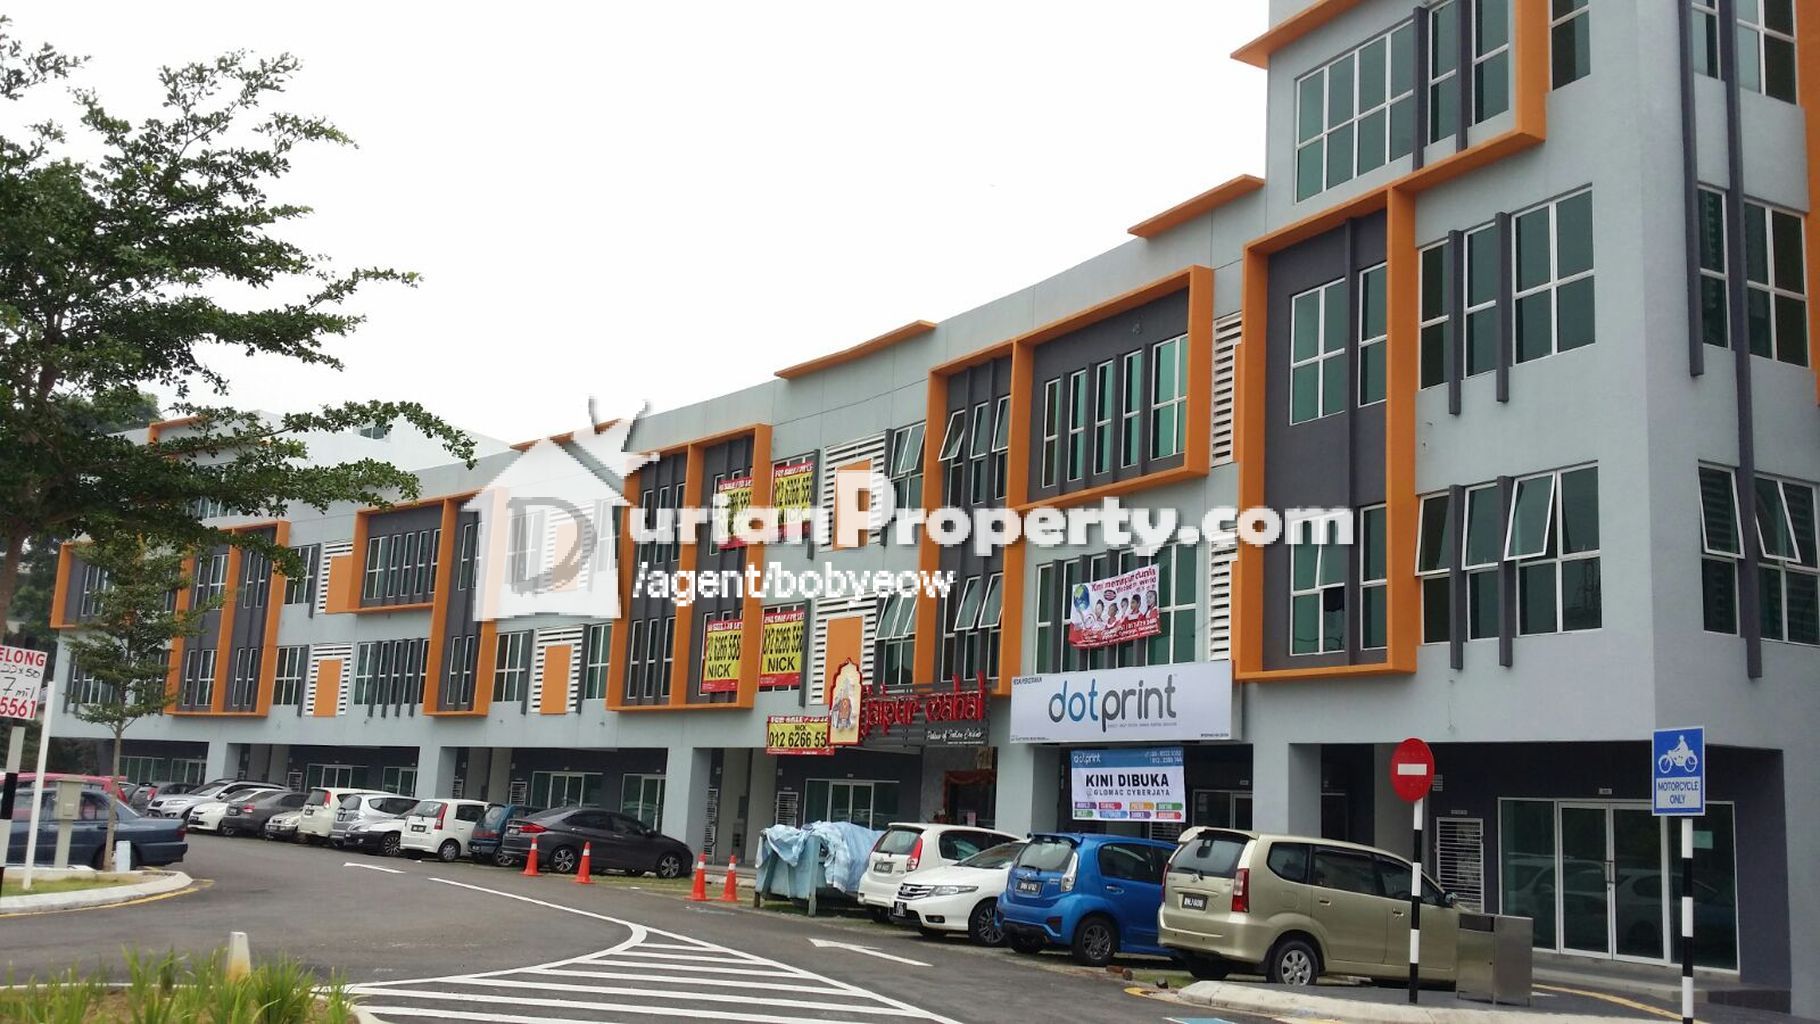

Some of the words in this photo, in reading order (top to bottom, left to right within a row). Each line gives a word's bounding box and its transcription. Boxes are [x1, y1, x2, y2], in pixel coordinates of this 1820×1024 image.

[707, 663, 732, 678] NICK
[767, 656, 796, 672] NICK
[1048, 673, 1178, 733] dotprint
[768, 731, 785, 748] 012
[788, 731, 812, 748] 6266
[814, 731, 828, 748] 55
[1086, 774, 1113, 787] KINI
[1118, 773, 1169, 787] DIBUKA
[1657, 781, 1699, 792] MOTORCYCLE
[1093, 788, 1124, 797] GLOMAC
[1126, 788, 1170, 797] CYBERJAYA
[1669, 794, 1686, 805] ONLY
